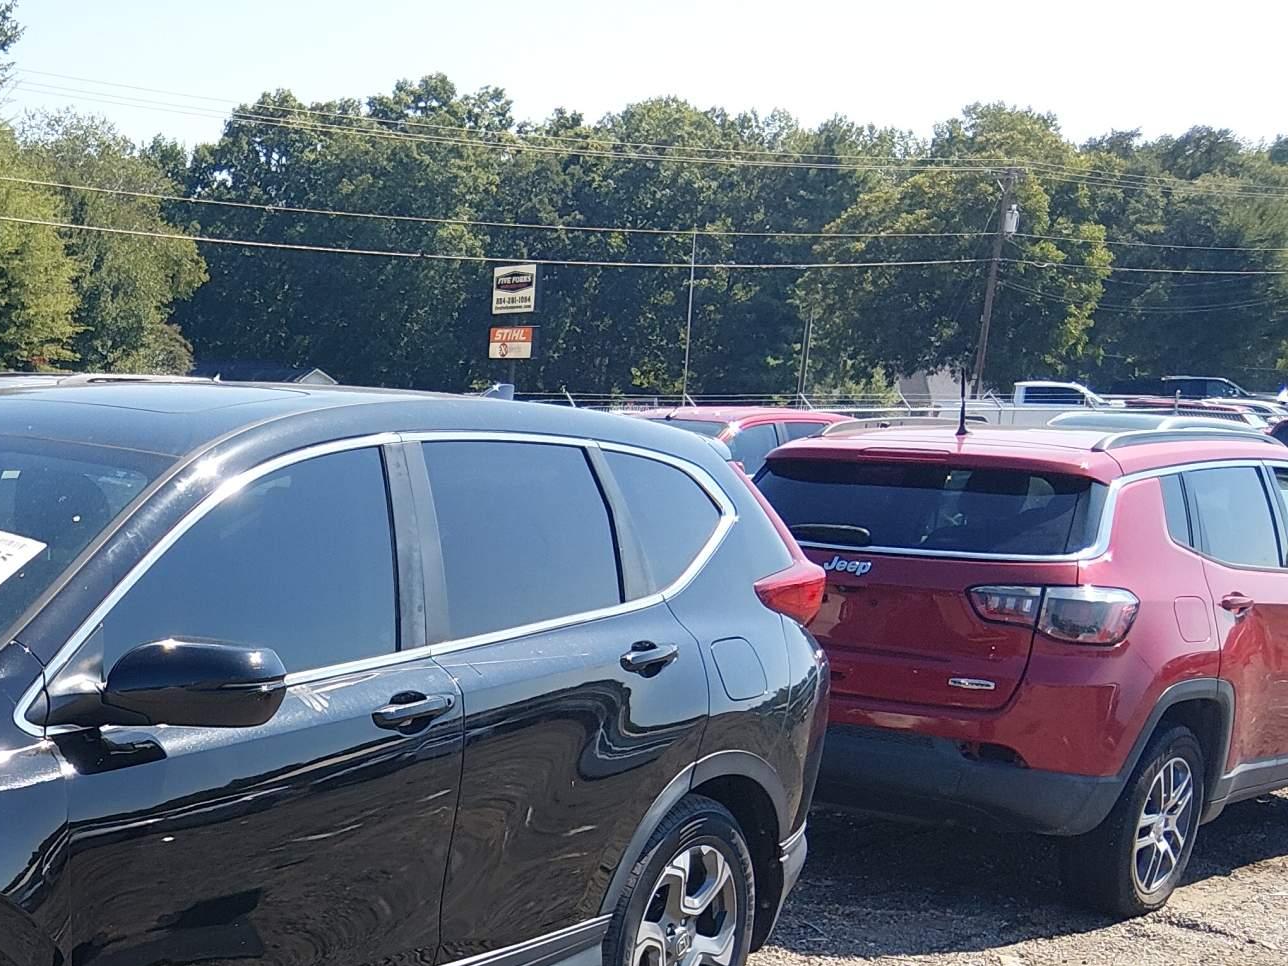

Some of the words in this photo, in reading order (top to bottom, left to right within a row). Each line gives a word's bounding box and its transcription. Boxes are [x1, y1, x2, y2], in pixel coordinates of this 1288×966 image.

[497, 277, 512, 285] FIVE
[494, 329, 527, 341] STIHL
[823, 555, 872, 576] Jeep
